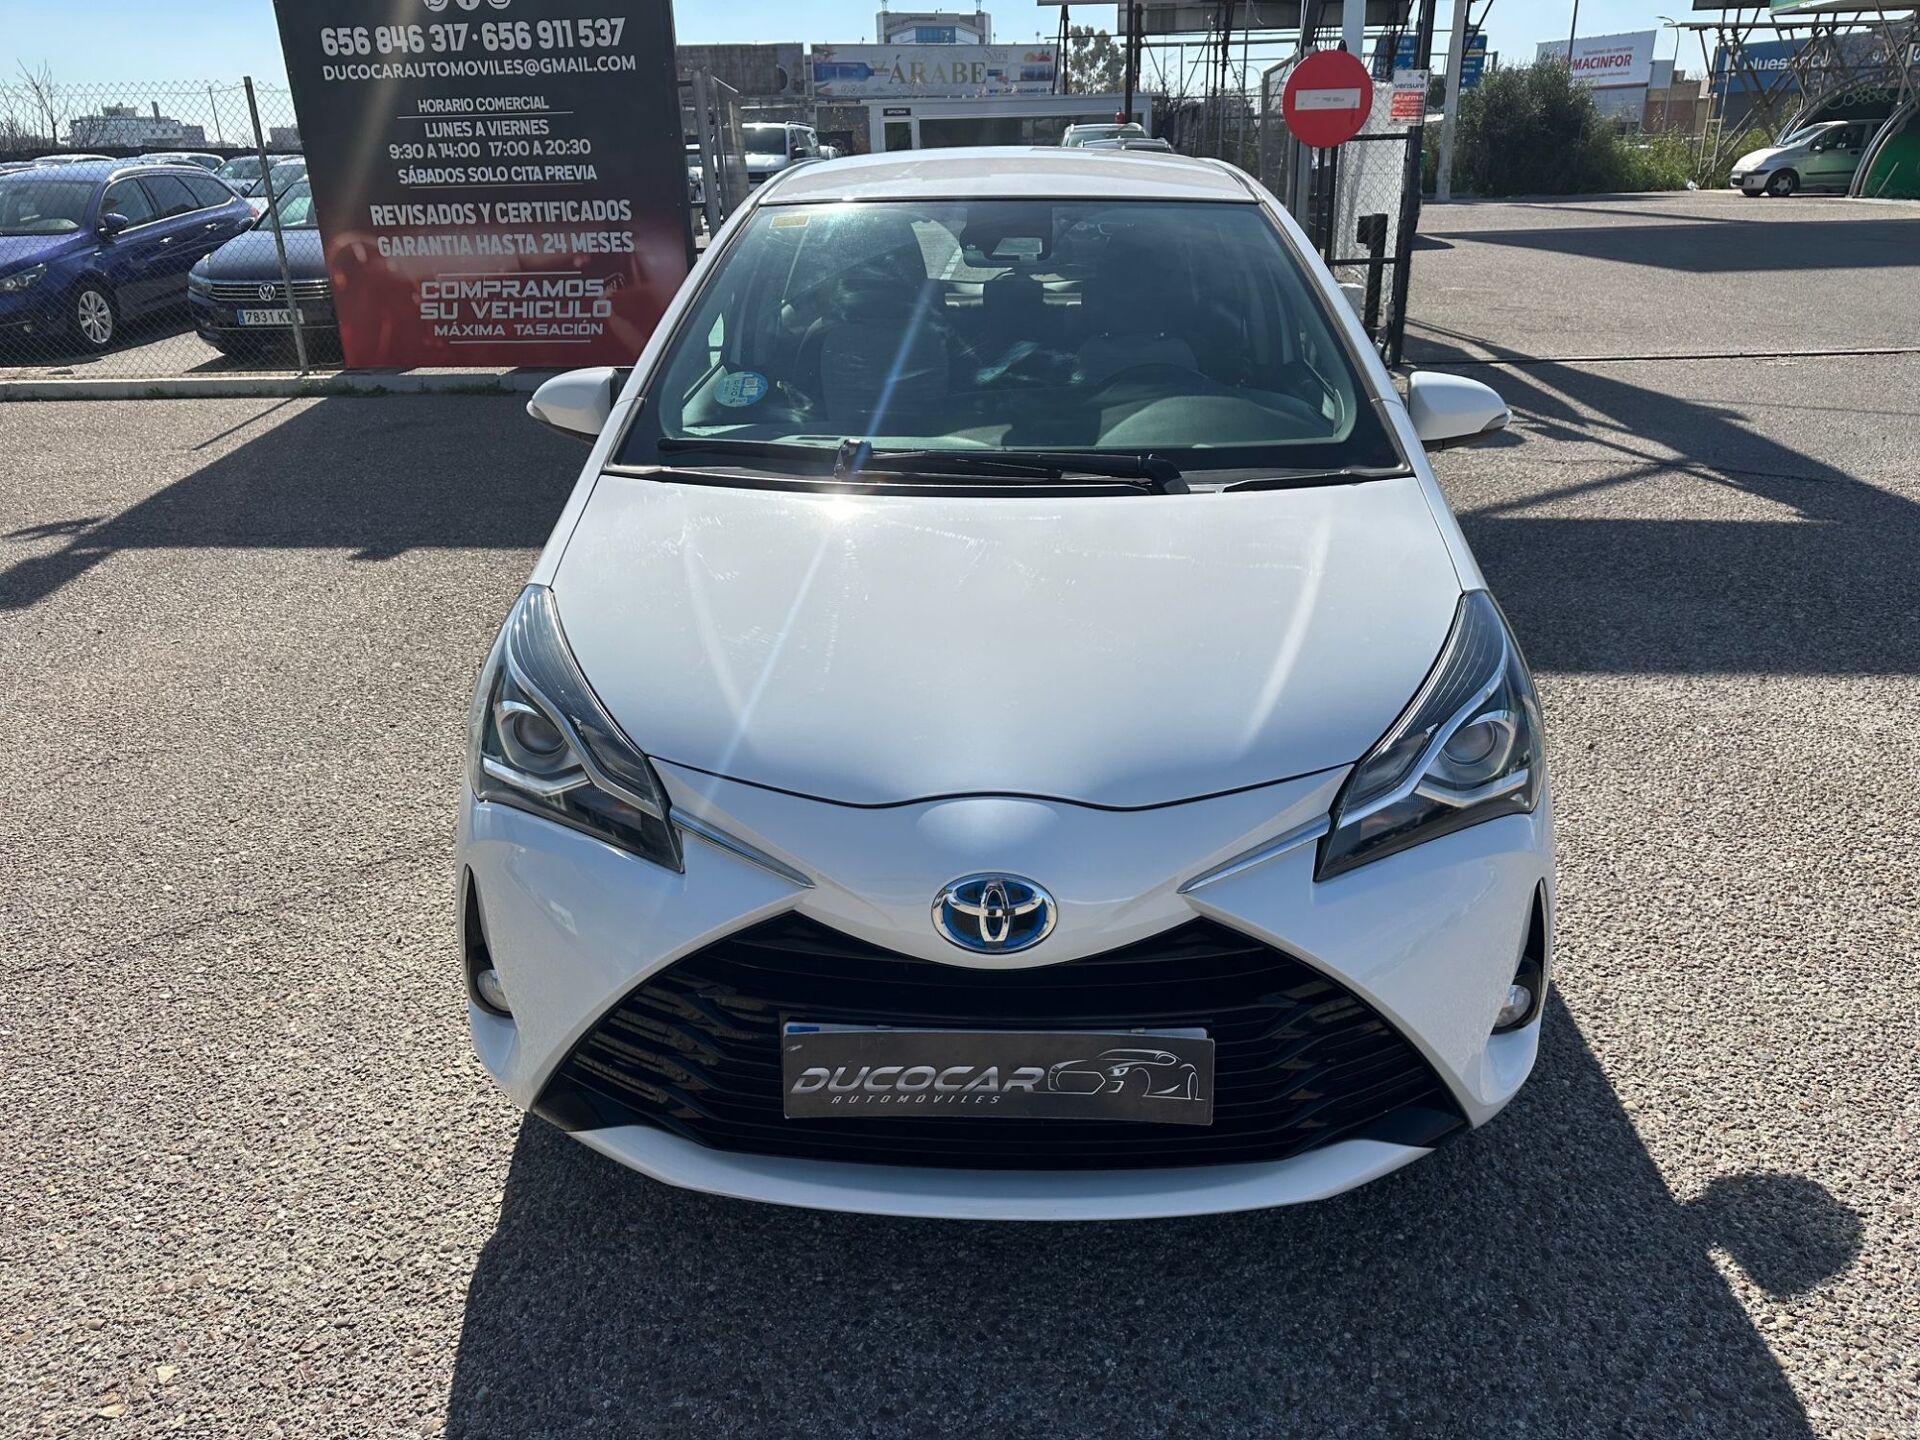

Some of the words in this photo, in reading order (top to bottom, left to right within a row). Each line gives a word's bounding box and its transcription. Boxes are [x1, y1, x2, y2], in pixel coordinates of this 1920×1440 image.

[320, 26, 371, 56] 656
[374, 24, 425, 54] 846
[429, 23, 469, 52] 317
[481, 21, 532, 51] 656
[536, 19, 574, 49] 911
[577, 17, 626, 48] 537
[322, 55, 636, 80] DUCOCARAUTOMOVILES@GMAIL.COM
[889, 55, 988, 84] ÁRABE
[1572, 54, 1633, 70] MACINFOR
[417, 98, 474, 113] HORARIO
[475, 96, 550, 111] COMERCIAL
[424, 121, 473, 138] LUNES
[475, 121, 486, 137] A
[486, 119, 550, 136] VIERNES
[389, 143, 424, 160] 9:30
[427, 144, 438, 159] A
[438, 141, 481, 158] 14:00
[488, 140, 530, 157] 17:00
[532, 140, 544, 156] A
[544, 138, 591, 155] 20:30
[398, 165, 466, 184] SÁBADOS
[468, 166, 509, 182] SOLO
[511, 165, 544, 181] CITA
[545, 164, 598, 180] PREVIA
[369, 203, 477, 226] REVISADOS
[479, 202, 492, 224] Y
[494, 199, 632, 224] CERTIFICADOS
[377, 235, 471, 257] GARANTIA
[476, 233, 538, 256] HASTA
[541, 232, 566, 254] 24
[571, 231, 635, 253] MESES
[420, 279, 605, 299] COMPRAMOS
[245, 311, 275, 323] 7831
[420, 302, 458, 320] SU
[471, 299, 613, 319] VEHICULO
[434, 321, 506, 336] MÁXIMA
[513, 319, 604, 336] TASACIÓN
[790, 1065, 1045, 1094] DUCOCAR
[831, 1095, 1001, 1104] AUTOMOVILES
